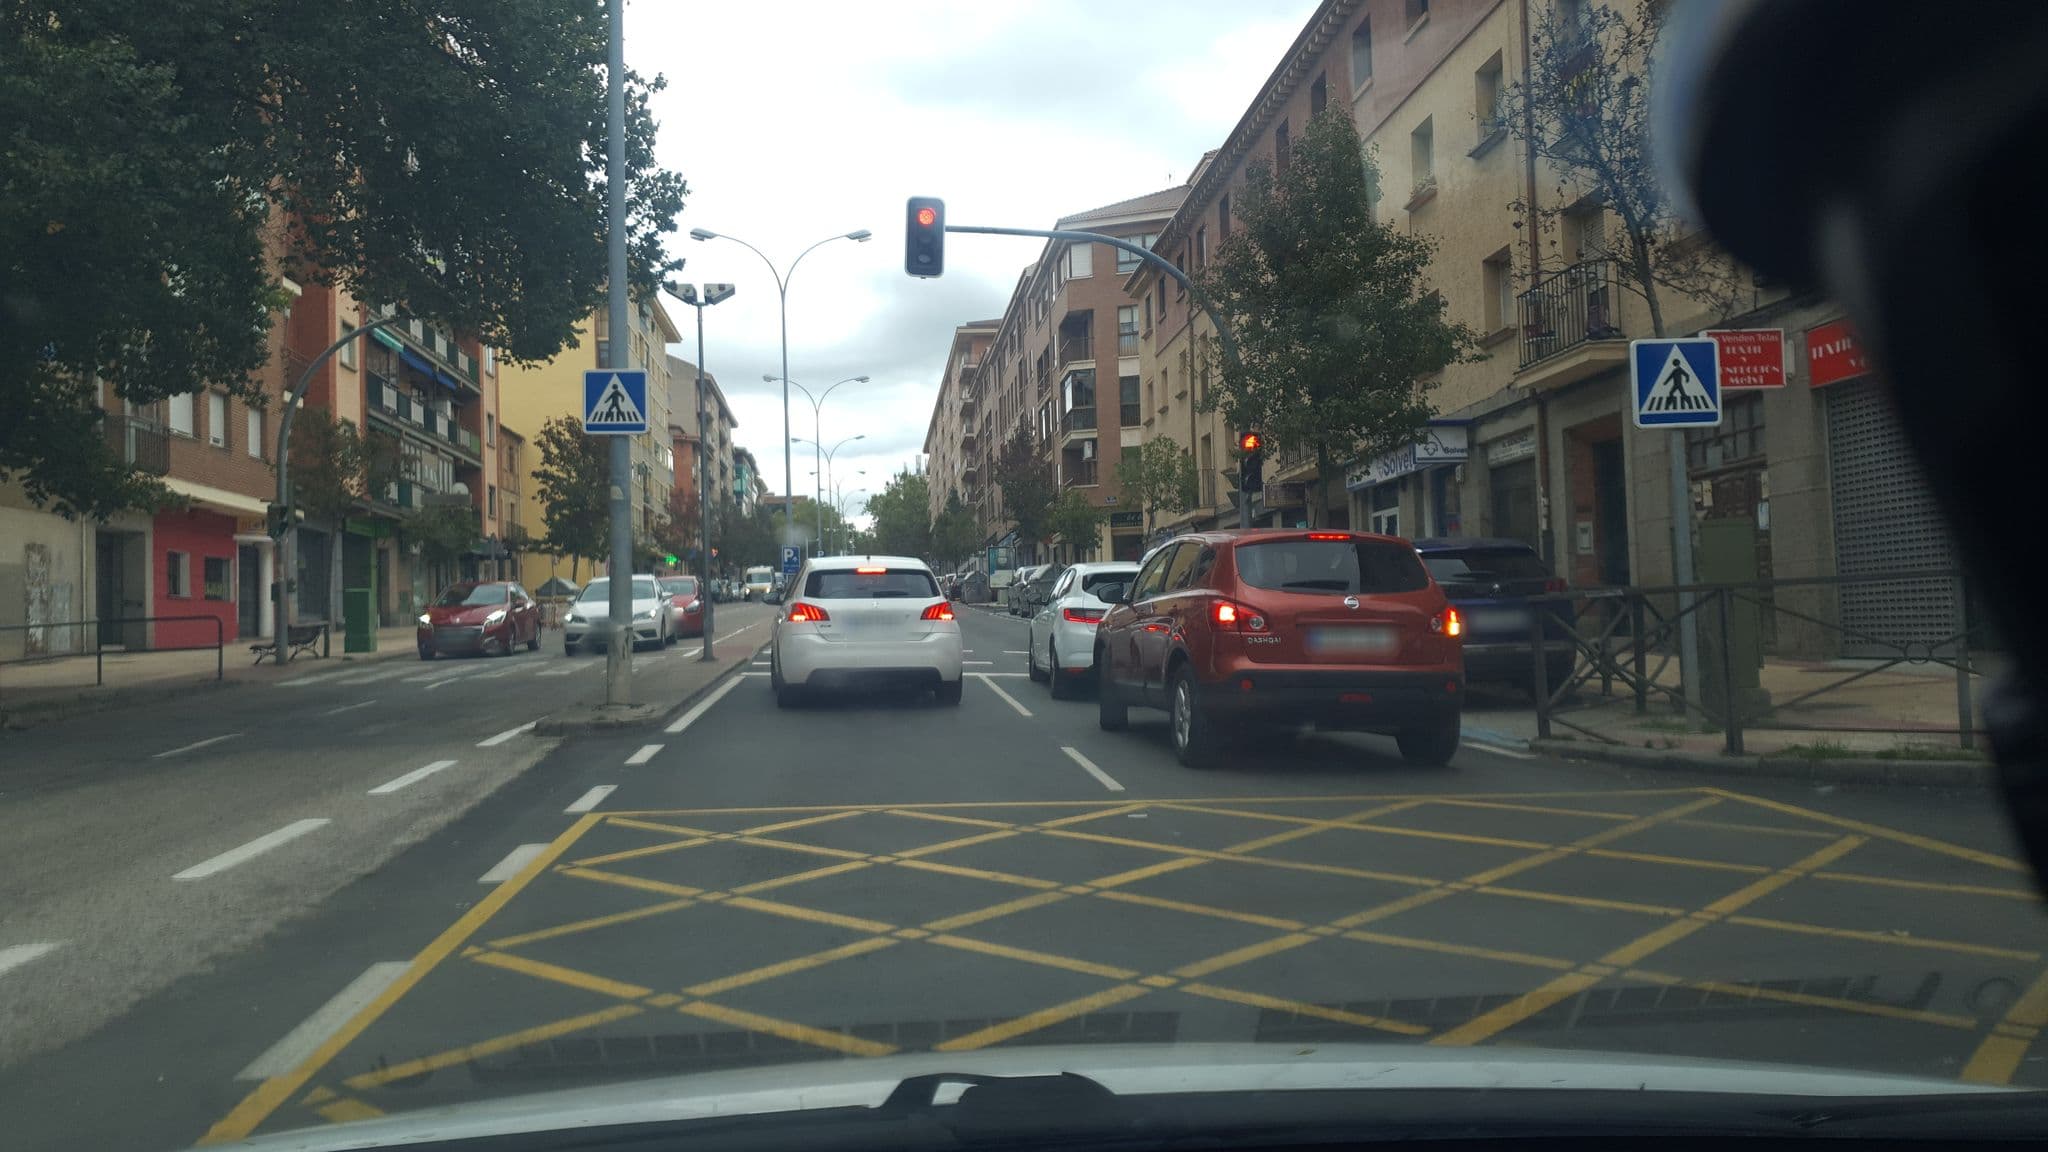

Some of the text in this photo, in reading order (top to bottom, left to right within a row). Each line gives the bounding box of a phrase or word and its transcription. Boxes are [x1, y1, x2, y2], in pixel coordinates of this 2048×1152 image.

[1722, 335, 1755, 343] Venden
[1757, 333, 1779, 342] Telas
[784, 549, 794, 562] P
